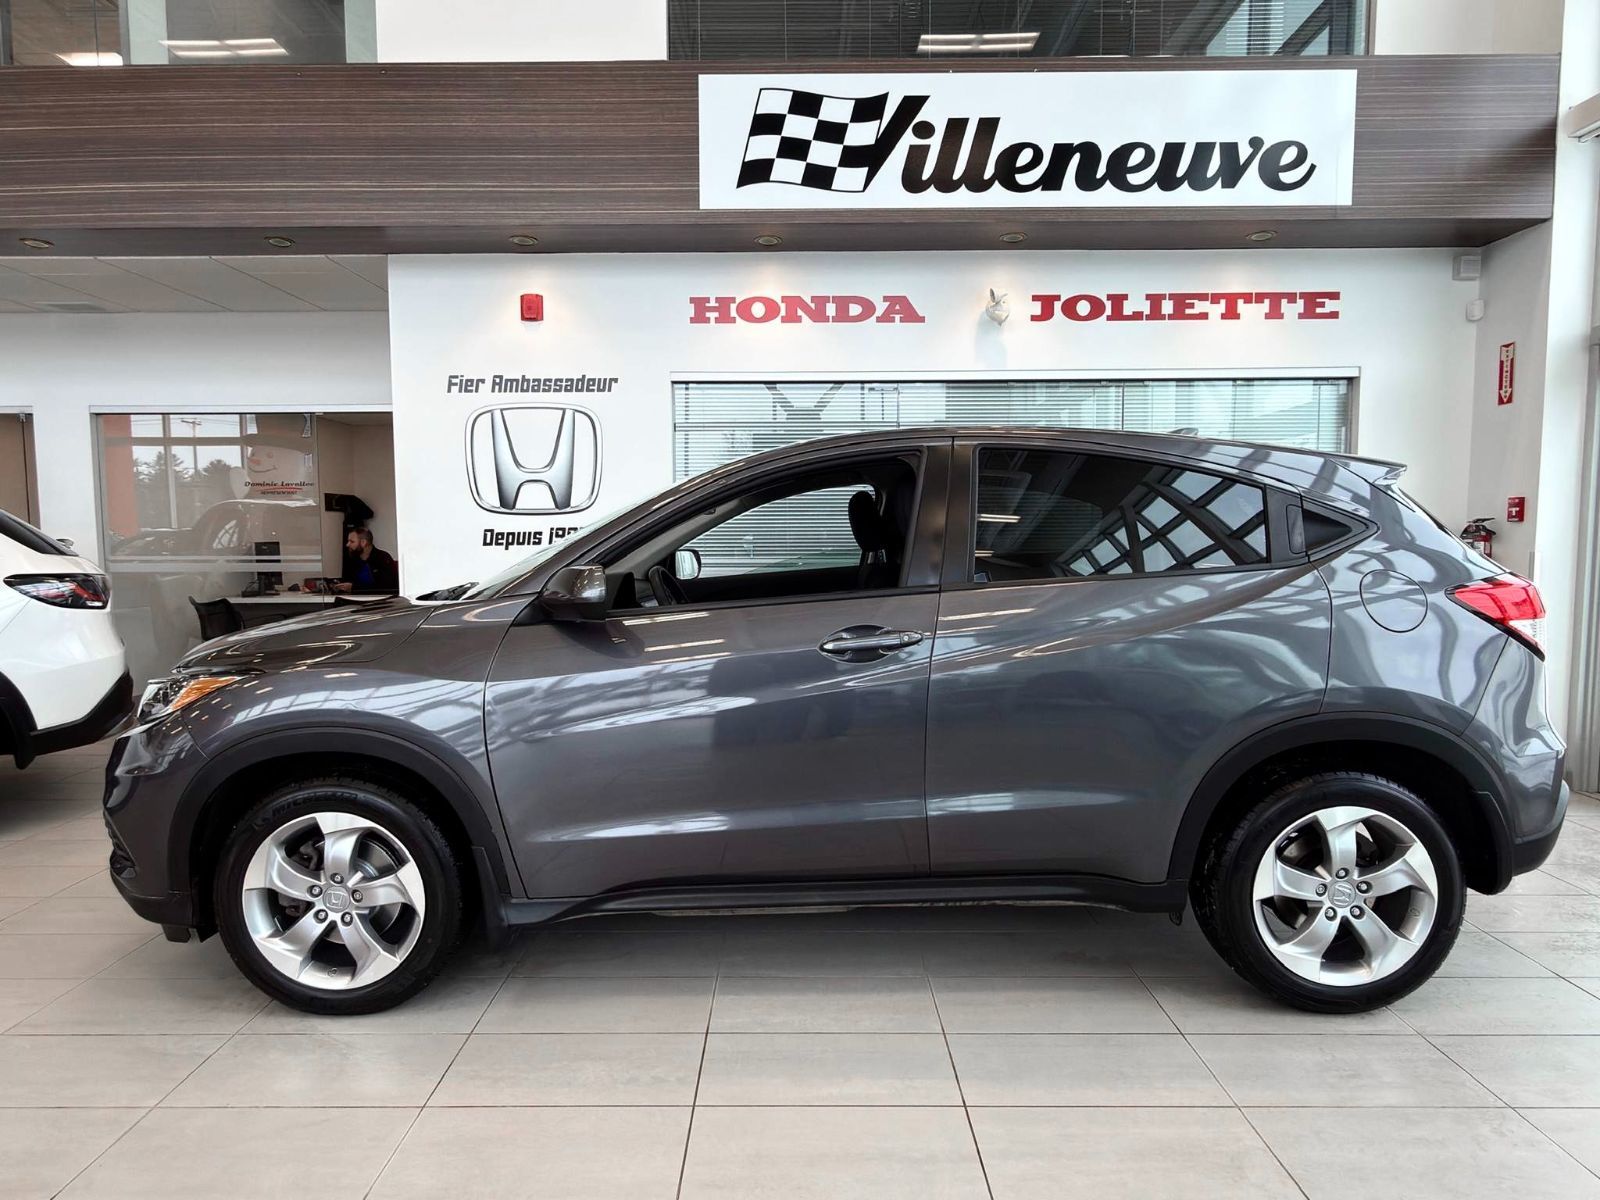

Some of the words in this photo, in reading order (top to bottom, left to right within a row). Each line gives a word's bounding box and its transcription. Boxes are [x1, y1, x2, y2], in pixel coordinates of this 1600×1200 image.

[862, 92, 1317, 194] Villeneuve
[690, 295, 925, 324] HONDA
[1030, 291, 1340, 321] JOLIETTE
[446, 374, 486, 394] Fier
[490, 373, 619, 393] Ambassadeur
[481, 528, 543, 551] Depuis
